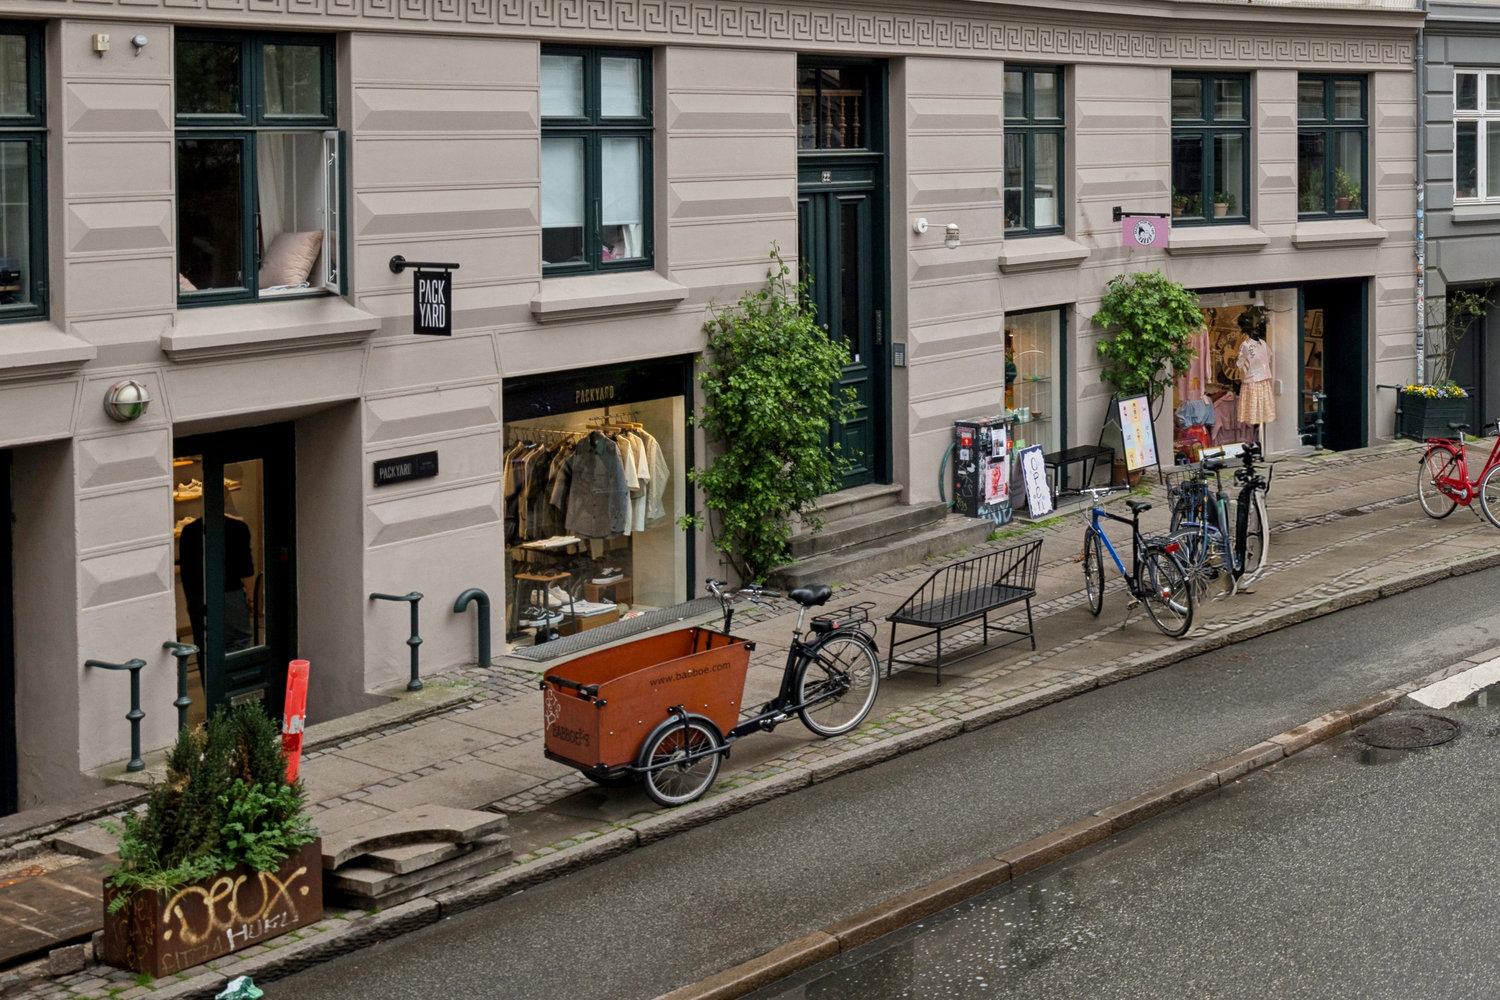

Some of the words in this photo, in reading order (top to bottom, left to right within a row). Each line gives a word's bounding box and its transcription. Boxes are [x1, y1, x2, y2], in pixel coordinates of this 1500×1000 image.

[419, 280, 445, 304] PACK
[419, 304, 446, 328] YARD
[575, 385, 615, 404] PACKYARD
[379, 462, 413, 480] PACKYARD
[649, 661, 732, 687] www.babboe.com
